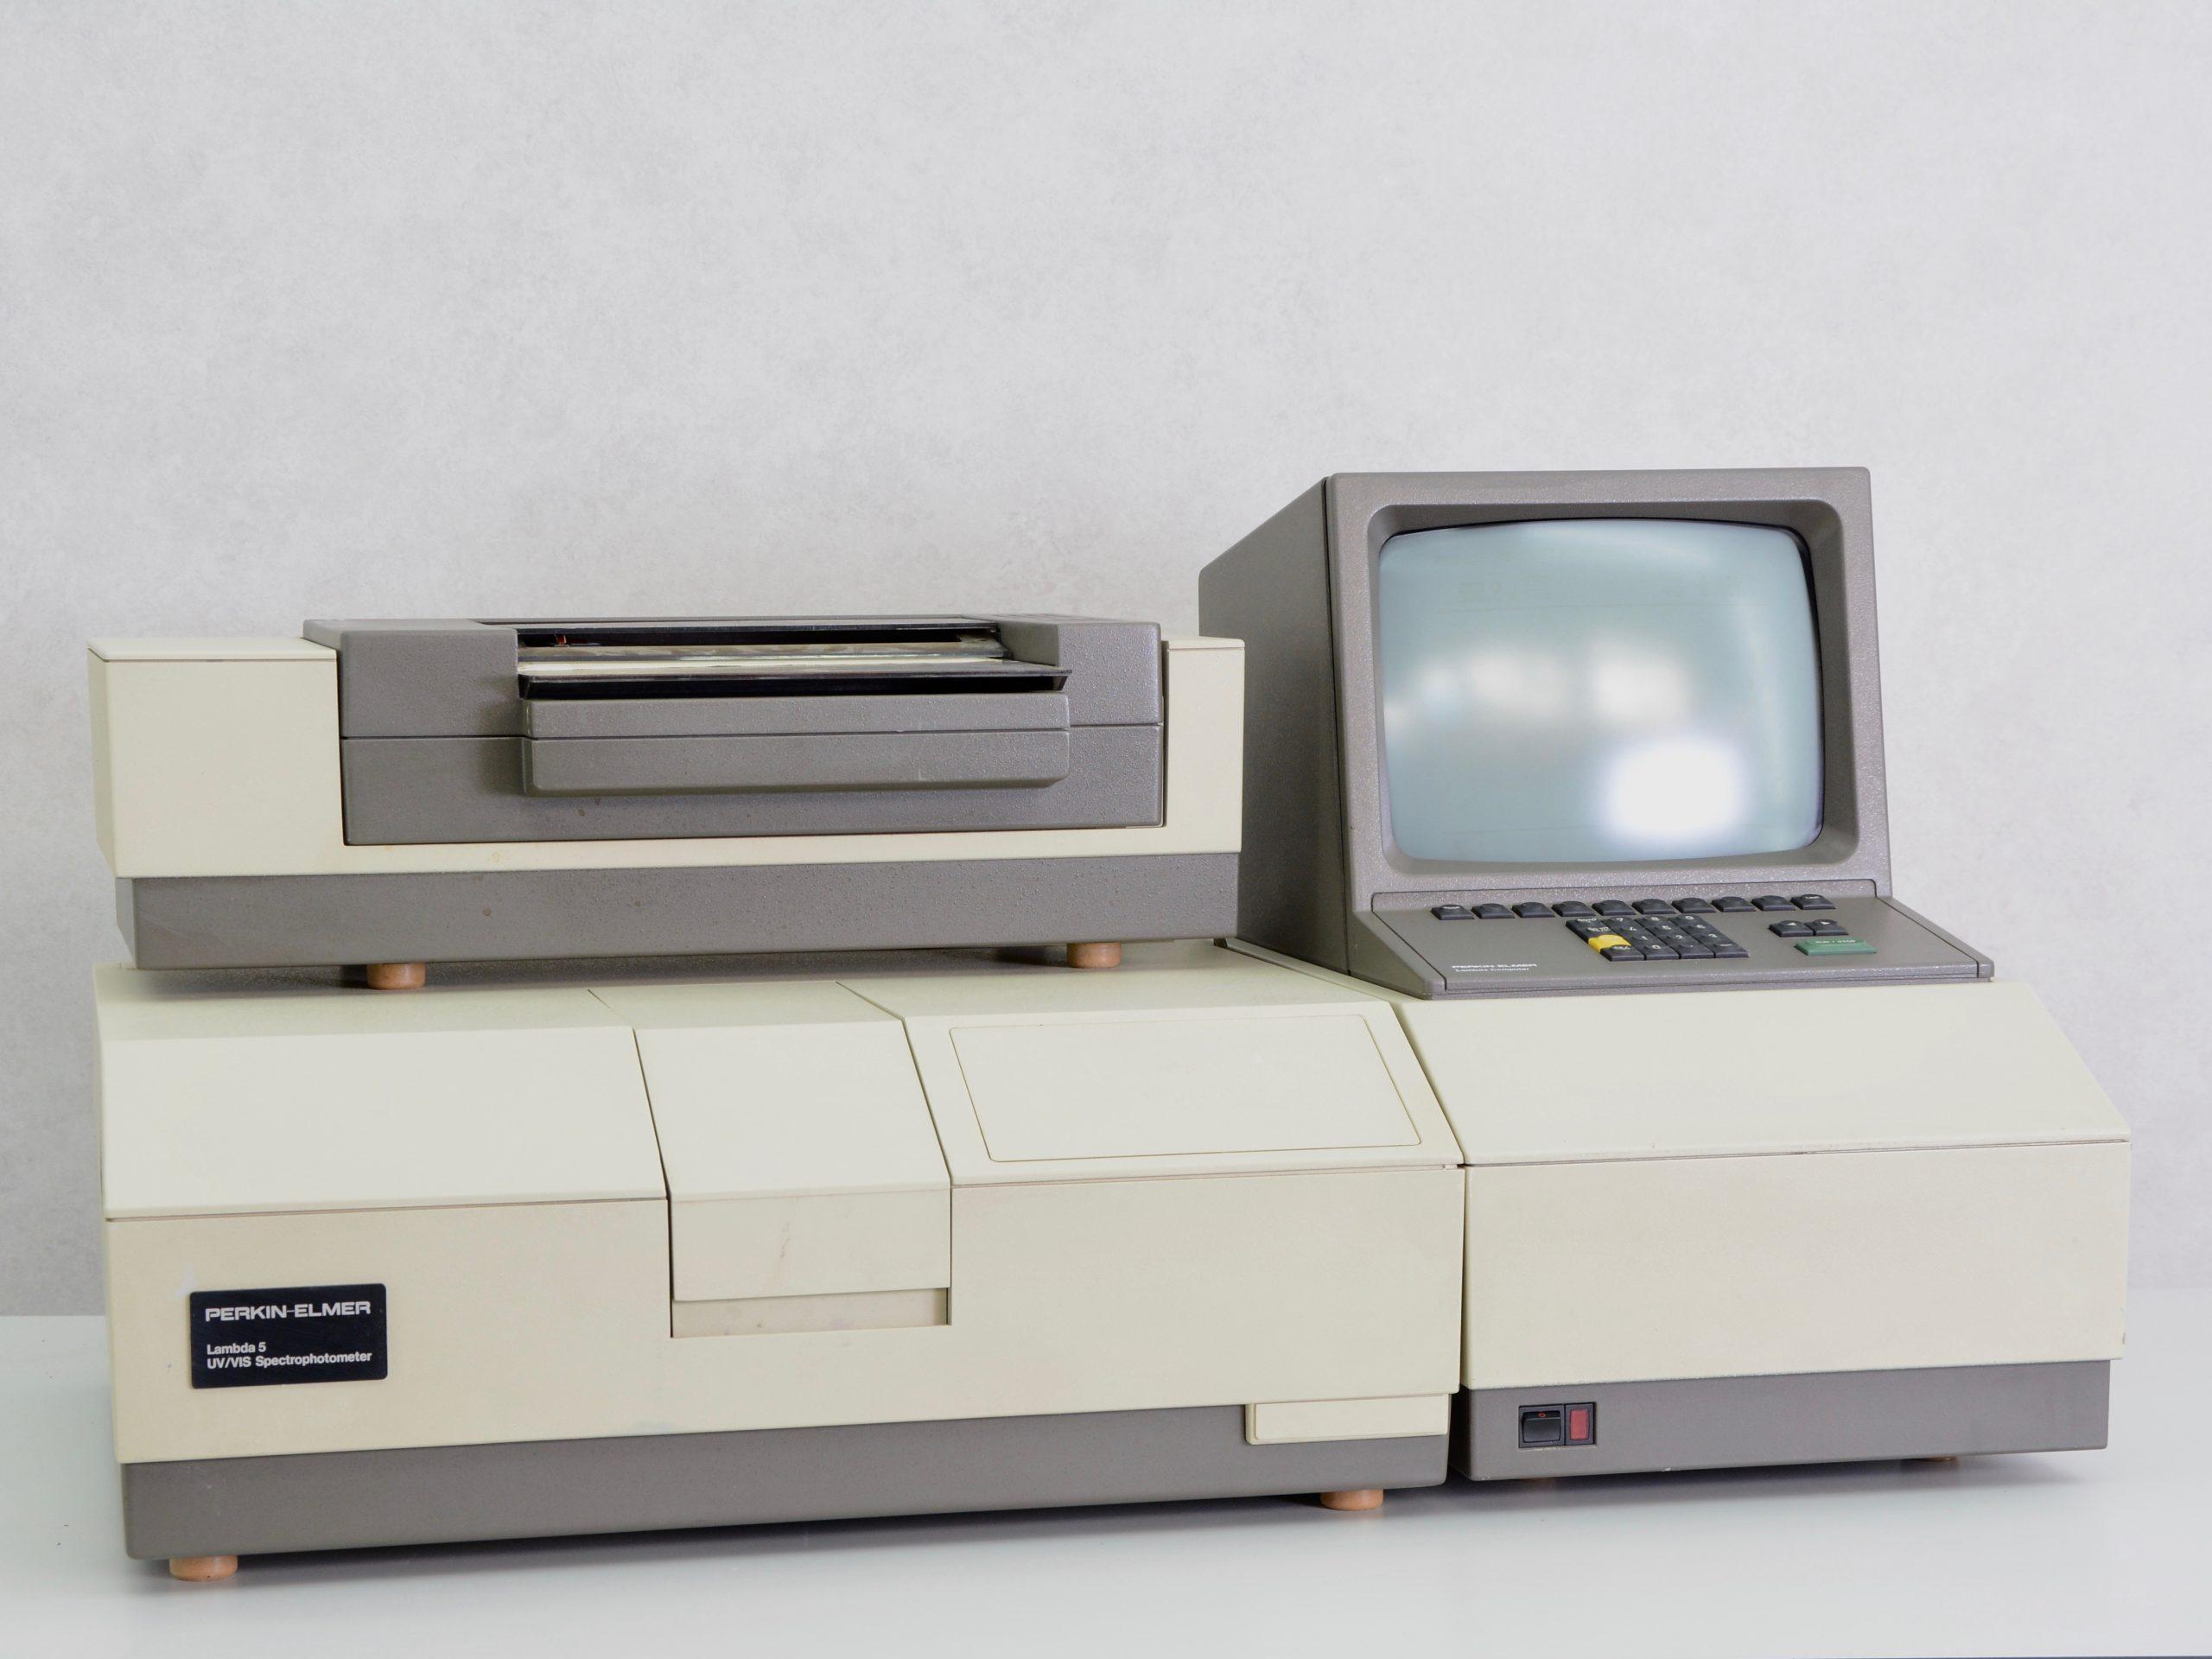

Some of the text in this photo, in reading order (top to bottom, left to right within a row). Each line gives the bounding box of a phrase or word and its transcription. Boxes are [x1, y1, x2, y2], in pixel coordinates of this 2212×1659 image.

[205, 1300, 372, 1322] PERKIN-ELMER
[207, 1341, 267, 1355] Lambda 5
[207, 1351, 372, 1370] UV/VIS Spectrophotometer
